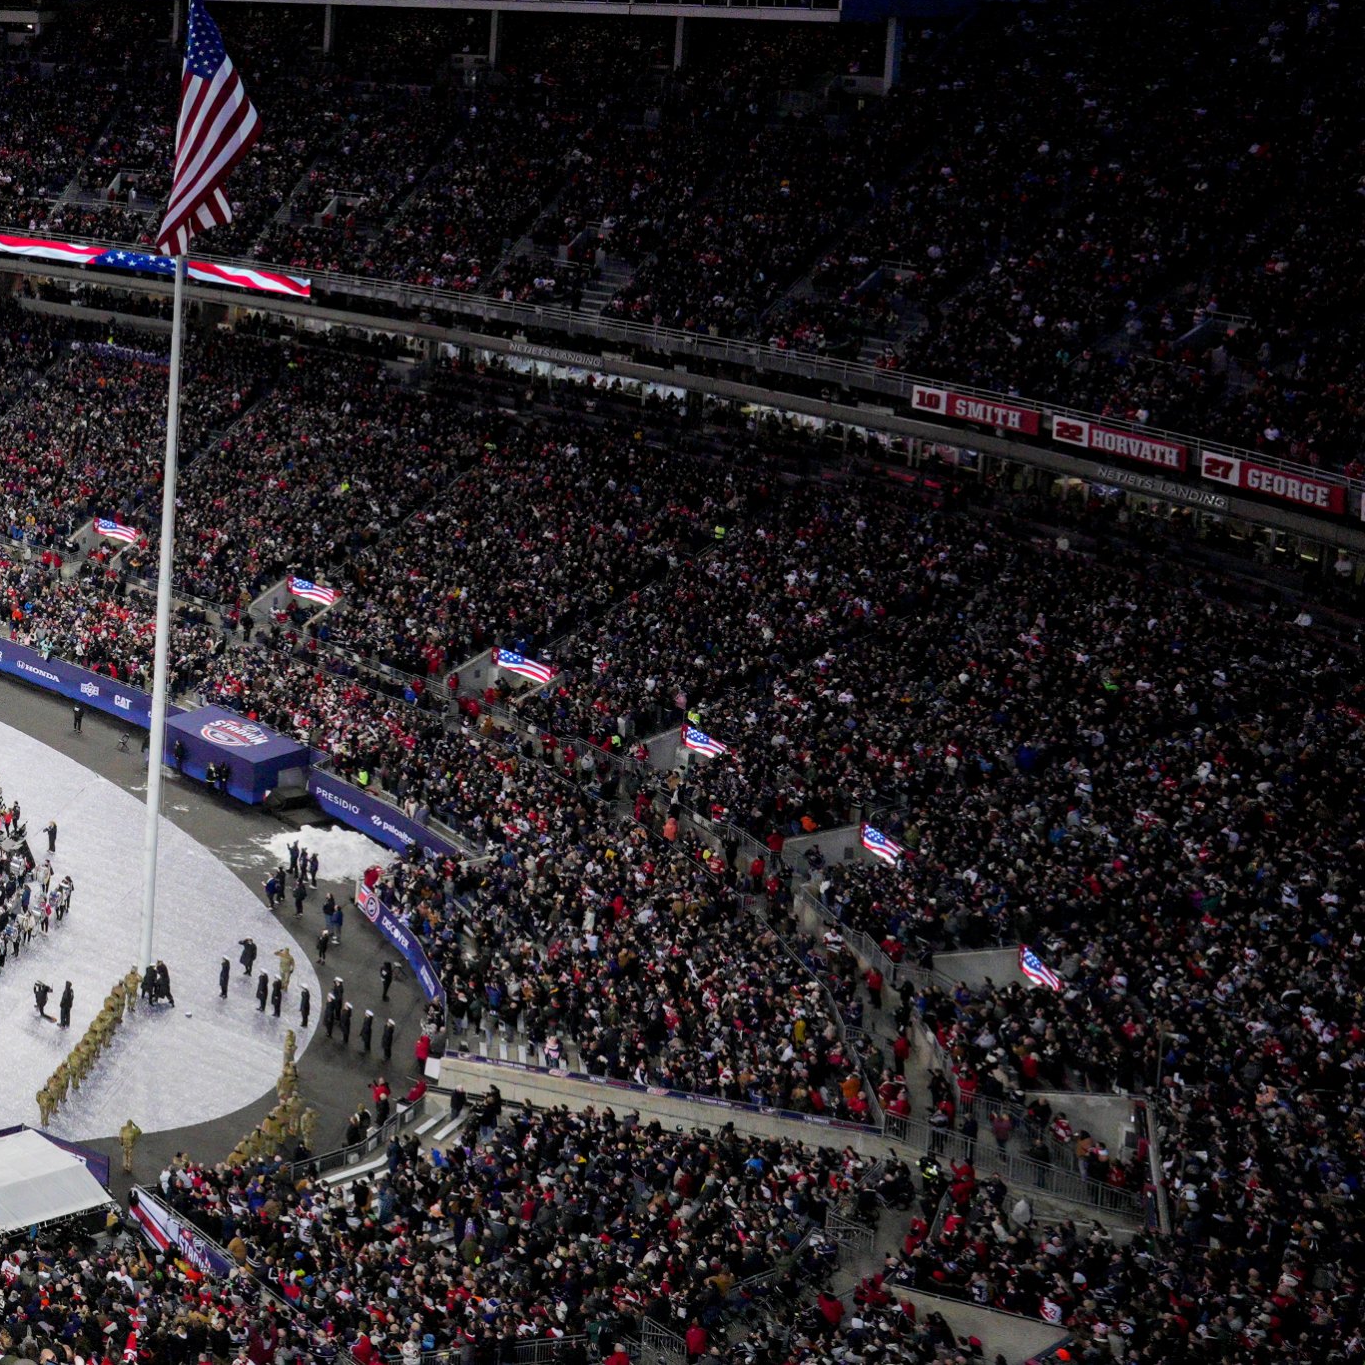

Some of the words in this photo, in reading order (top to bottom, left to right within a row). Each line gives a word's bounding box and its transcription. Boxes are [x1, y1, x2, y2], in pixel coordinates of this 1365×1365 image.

[554, 351, 603, 367] LANDING
[916, 390, 941, 409] 10
[955, 399, 1022, 429] SMITH
[1055, 421, 1084, 443] 22
[1091, 428, 1180, 467] HORVATH
[1204, 457, 1234, 480] 27
[1159, 483, 1227, 508] LANDING
[1247, 468, 1330, 507] GEORGE
[24, 663, 60, 683] HONDA
[114, 694, 133, 711] CAT
[210, 719, 269, 746] STADIUM
[315, 786, 360, 815] PRESIDIO
